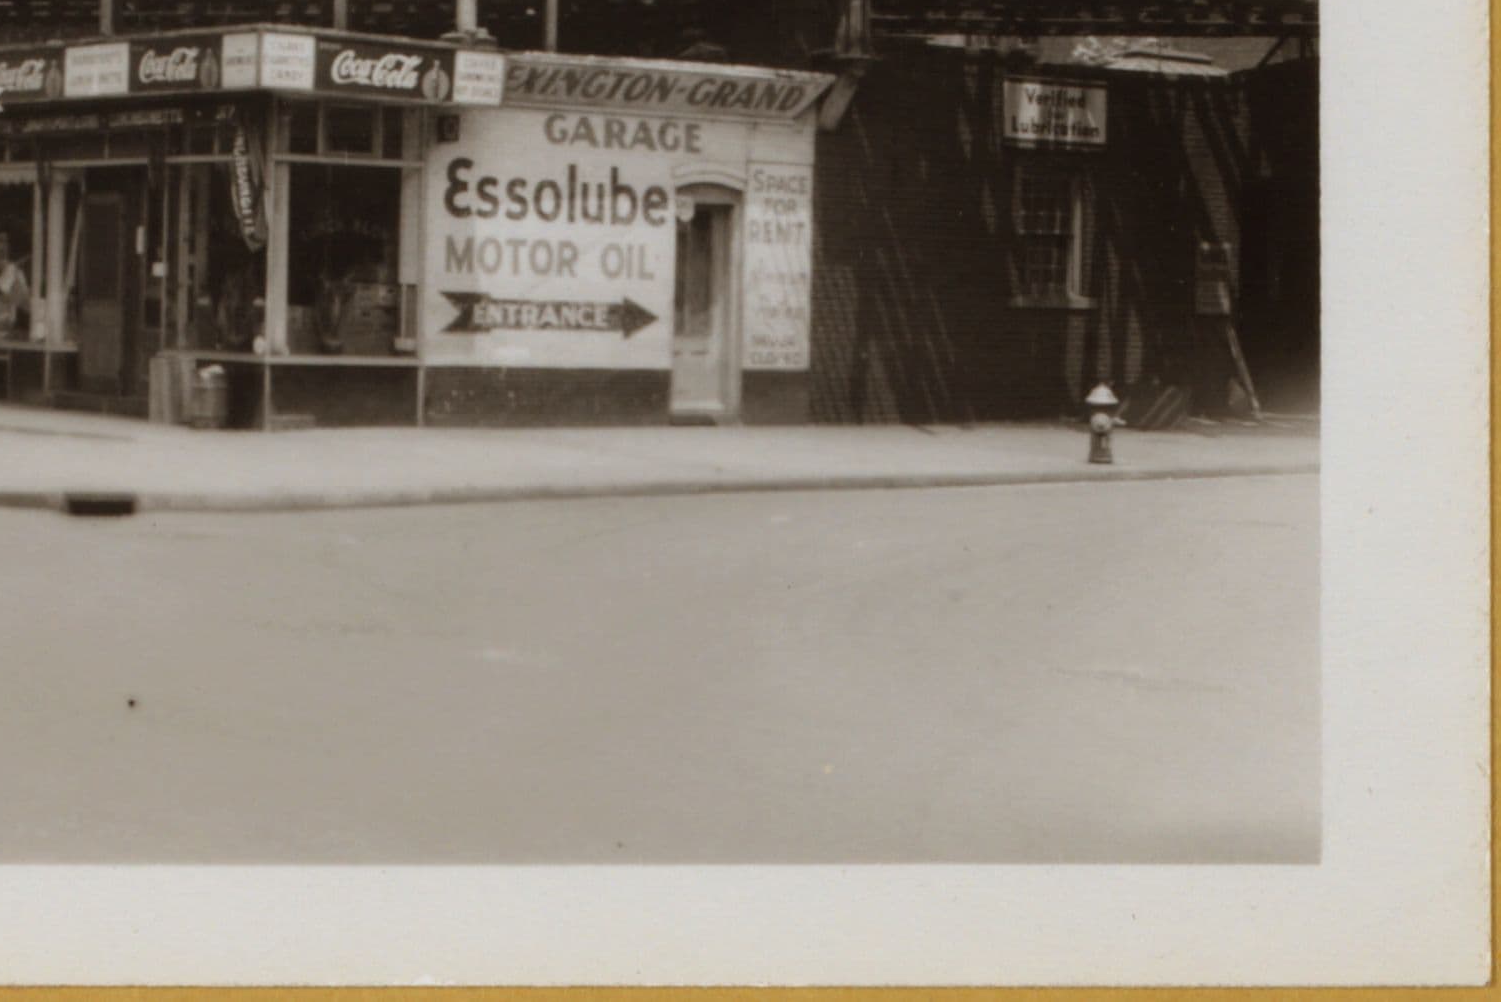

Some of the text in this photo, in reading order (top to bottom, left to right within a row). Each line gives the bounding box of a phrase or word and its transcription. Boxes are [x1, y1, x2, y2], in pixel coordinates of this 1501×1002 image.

[505, 64, 806, 112] EXINGTON-GRAND
[544, 113, 703, 154] GARAGE
[444, 157, 668, 227] Essolube
[445, 234, 655, 281] MOTOR OIL
[472, 302, 608, 329] ENTRANCE
